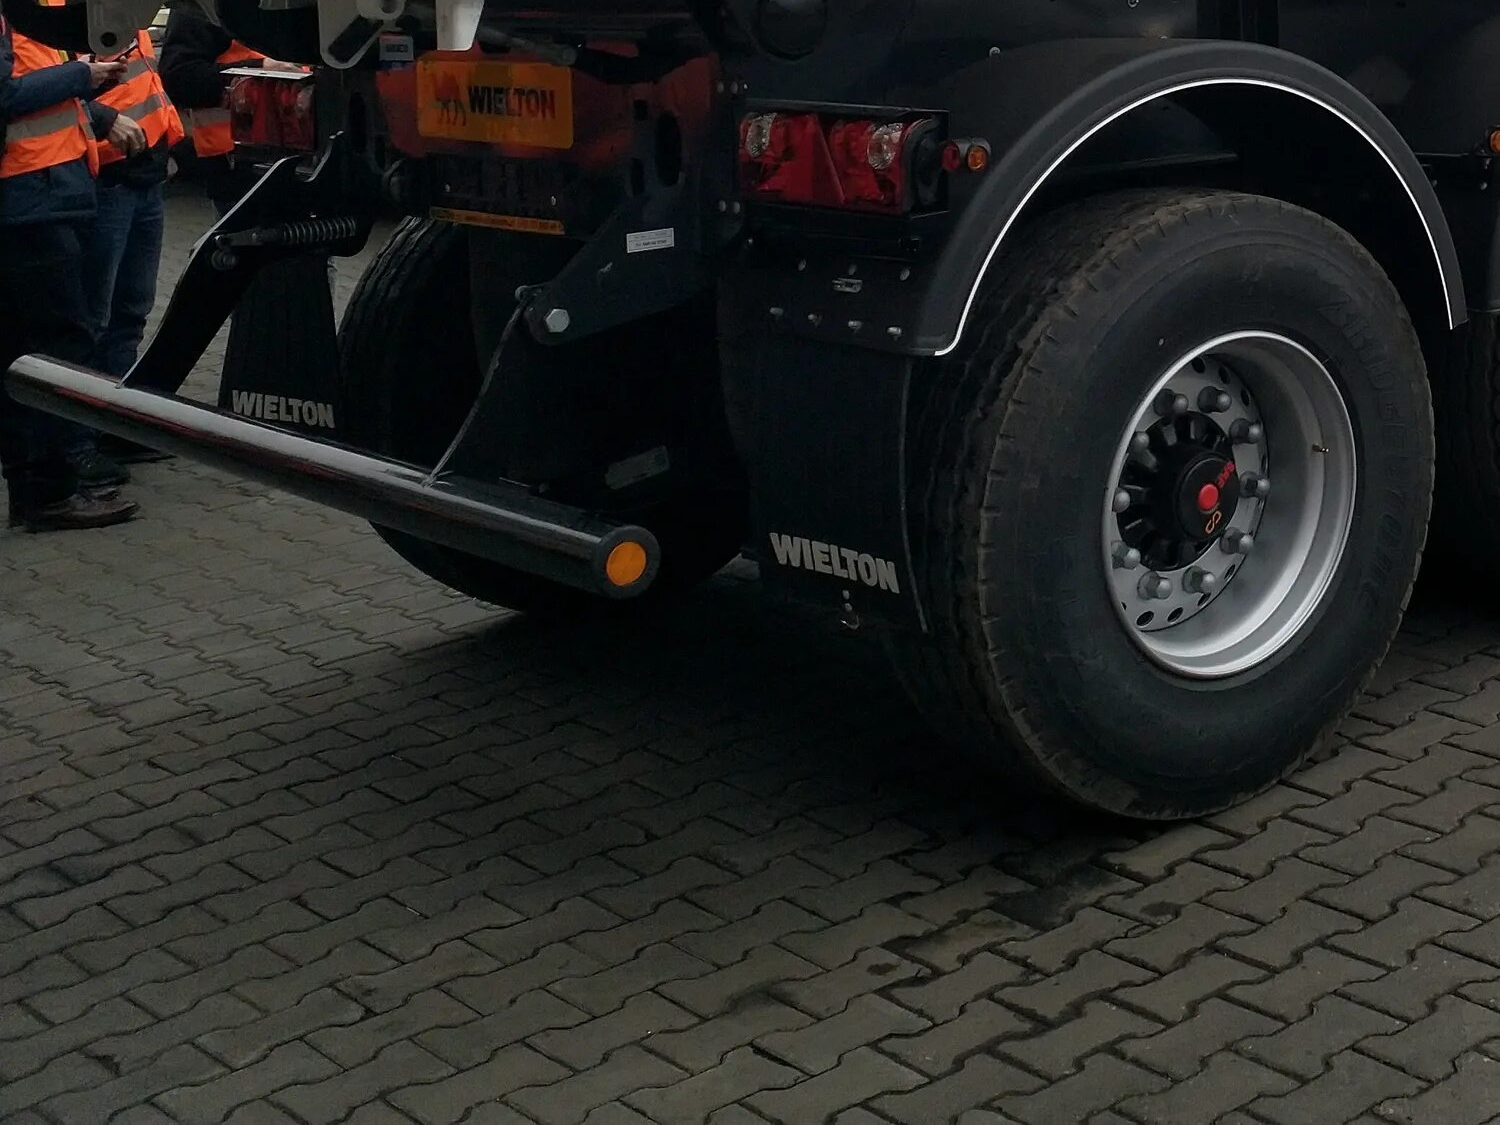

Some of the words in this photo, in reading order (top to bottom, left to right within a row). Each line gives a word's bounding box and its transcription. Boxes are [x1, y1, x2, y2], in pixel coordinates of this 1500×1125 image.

[468, 84, 556, 119] WIELTON
[232, 389, 336, 429] WIELTON
[768, 532, 901, 594] WIELTON
